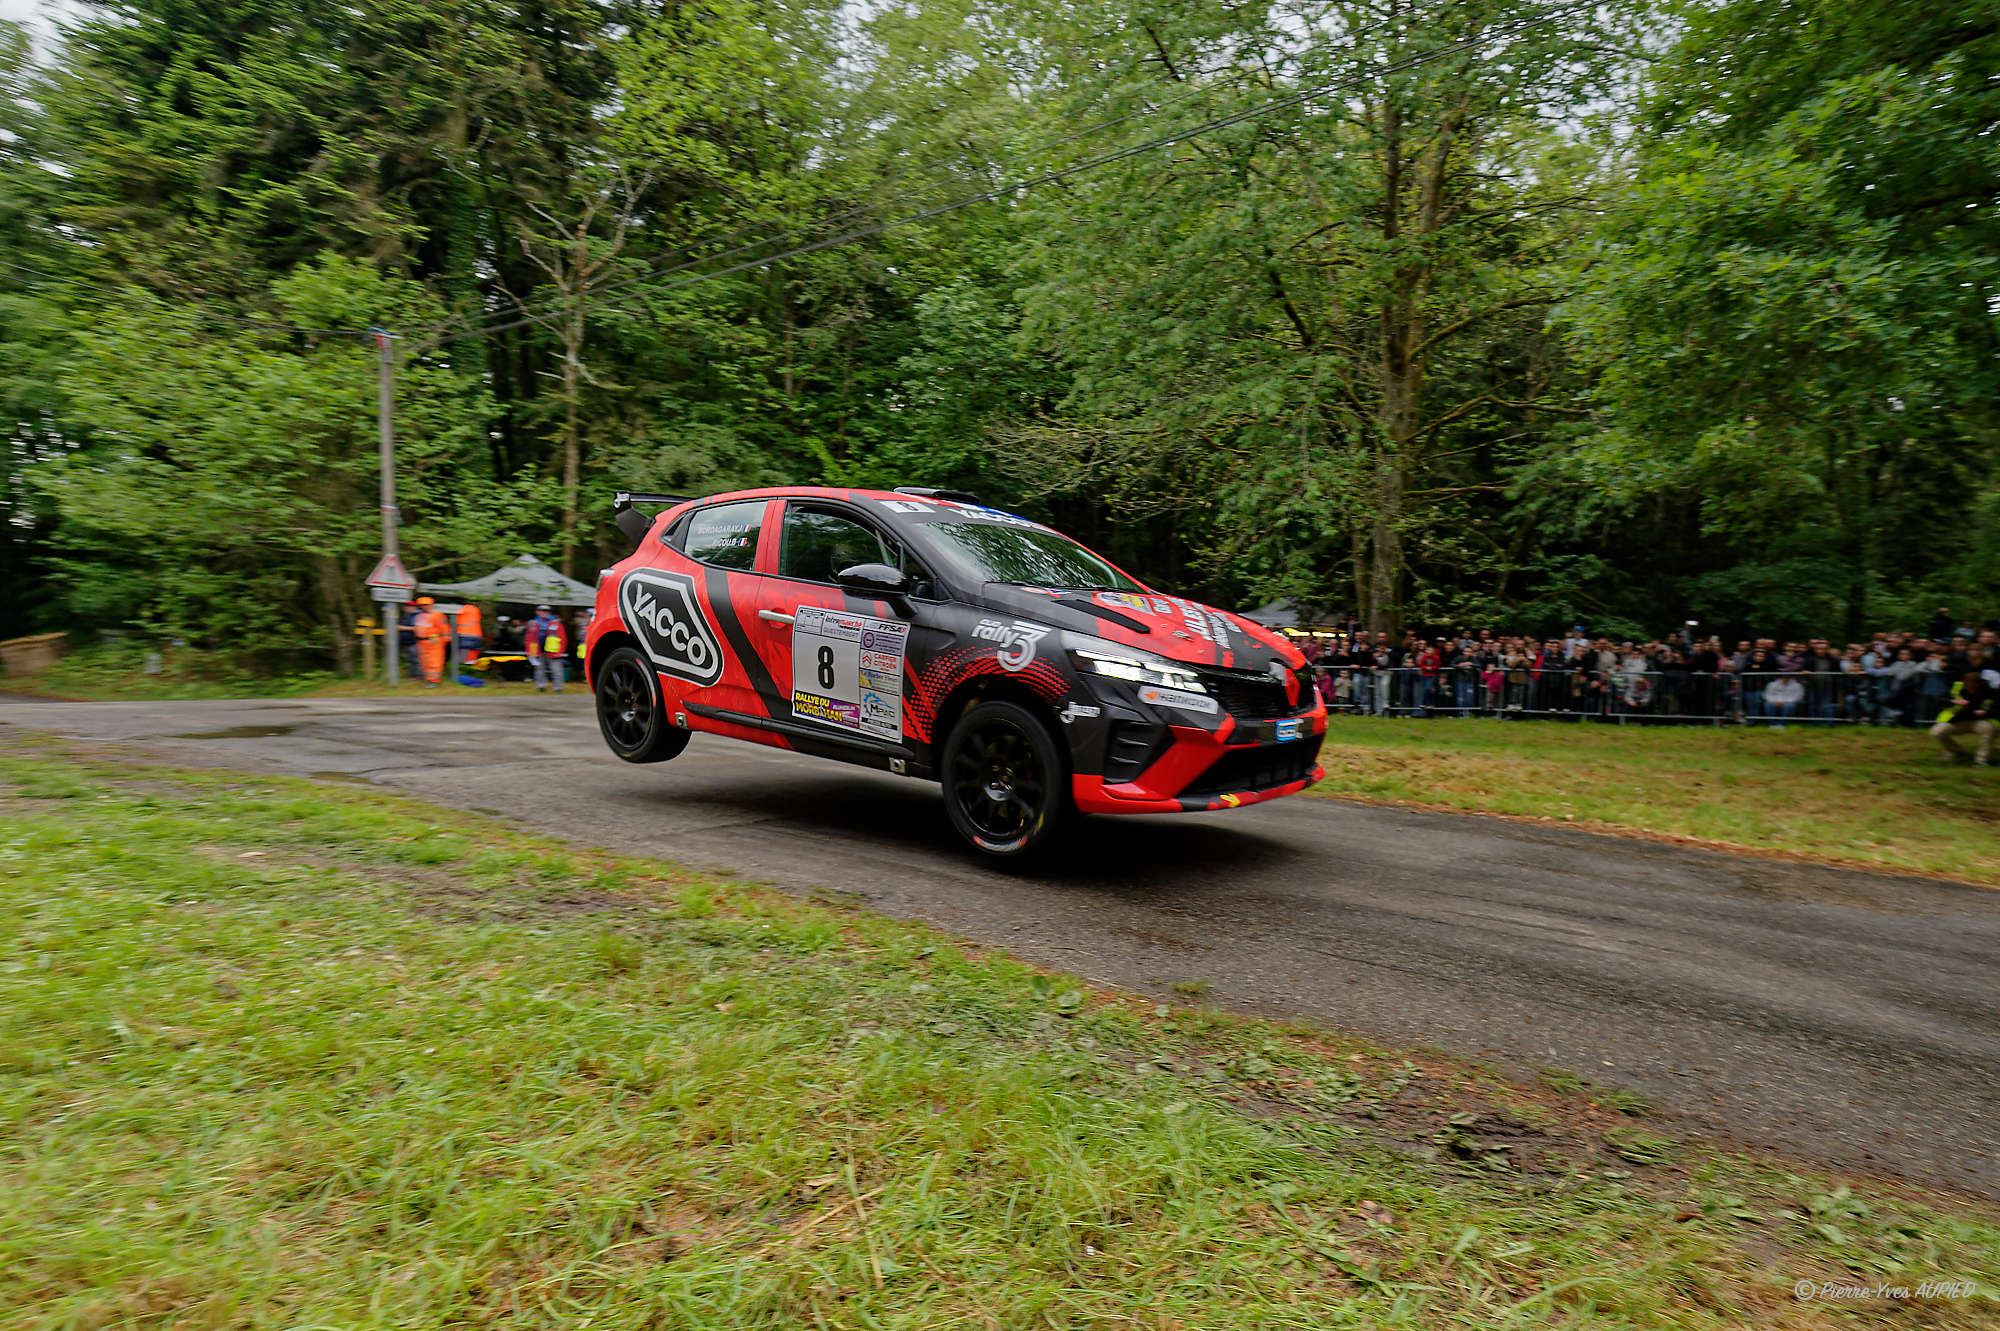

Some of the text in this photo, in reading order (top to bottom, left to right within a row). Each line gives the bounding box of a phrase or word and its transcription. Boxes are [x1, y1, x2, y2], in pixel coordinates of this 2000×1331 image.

[633, 583, 706, 666] YACCO
[997, 620, 1053, 672] 3
[817, 645, 835, 690] 8
[795, 691, 819, 705] RALLYE
[820, 697, 830, 708] DU
